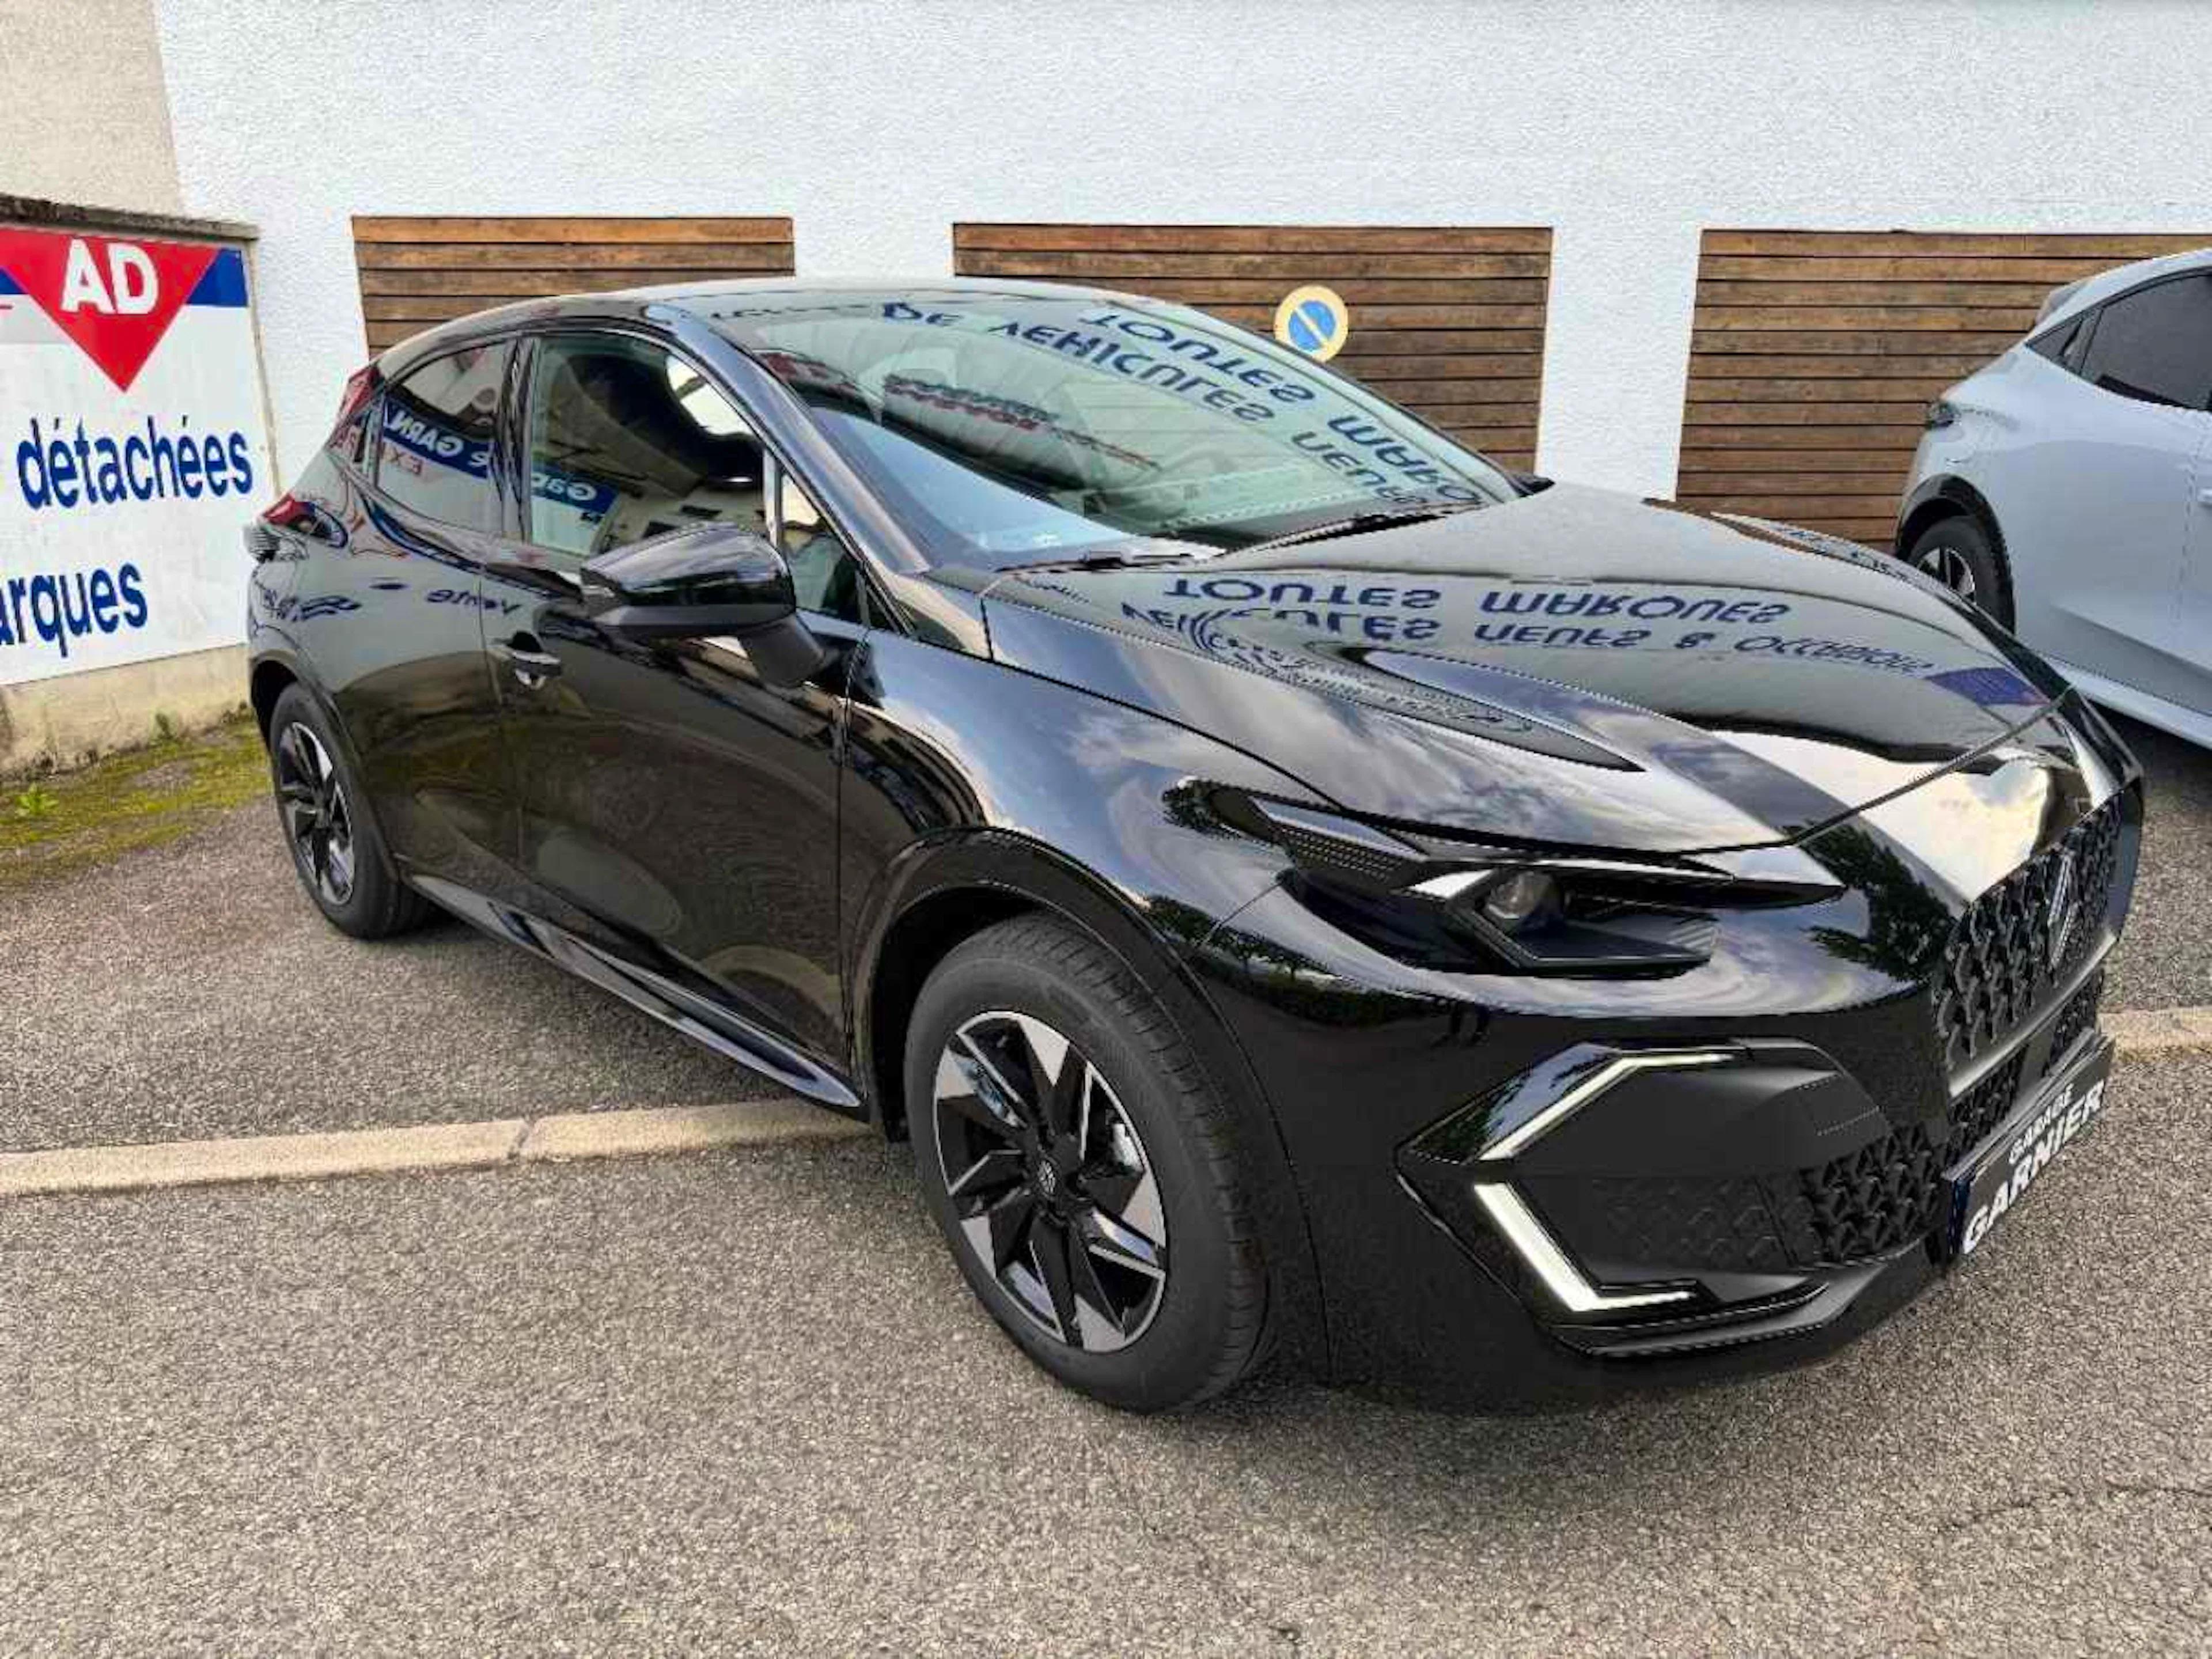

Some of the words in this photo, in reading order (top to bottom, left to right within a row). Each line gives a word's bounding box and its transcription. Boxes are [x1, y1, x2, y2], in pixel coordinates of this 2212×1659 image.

[61, 238, 160, 315] AD
[17, 415, 253, 510] détachées
[1963, 1080, 2105, 1255] GARNIER
